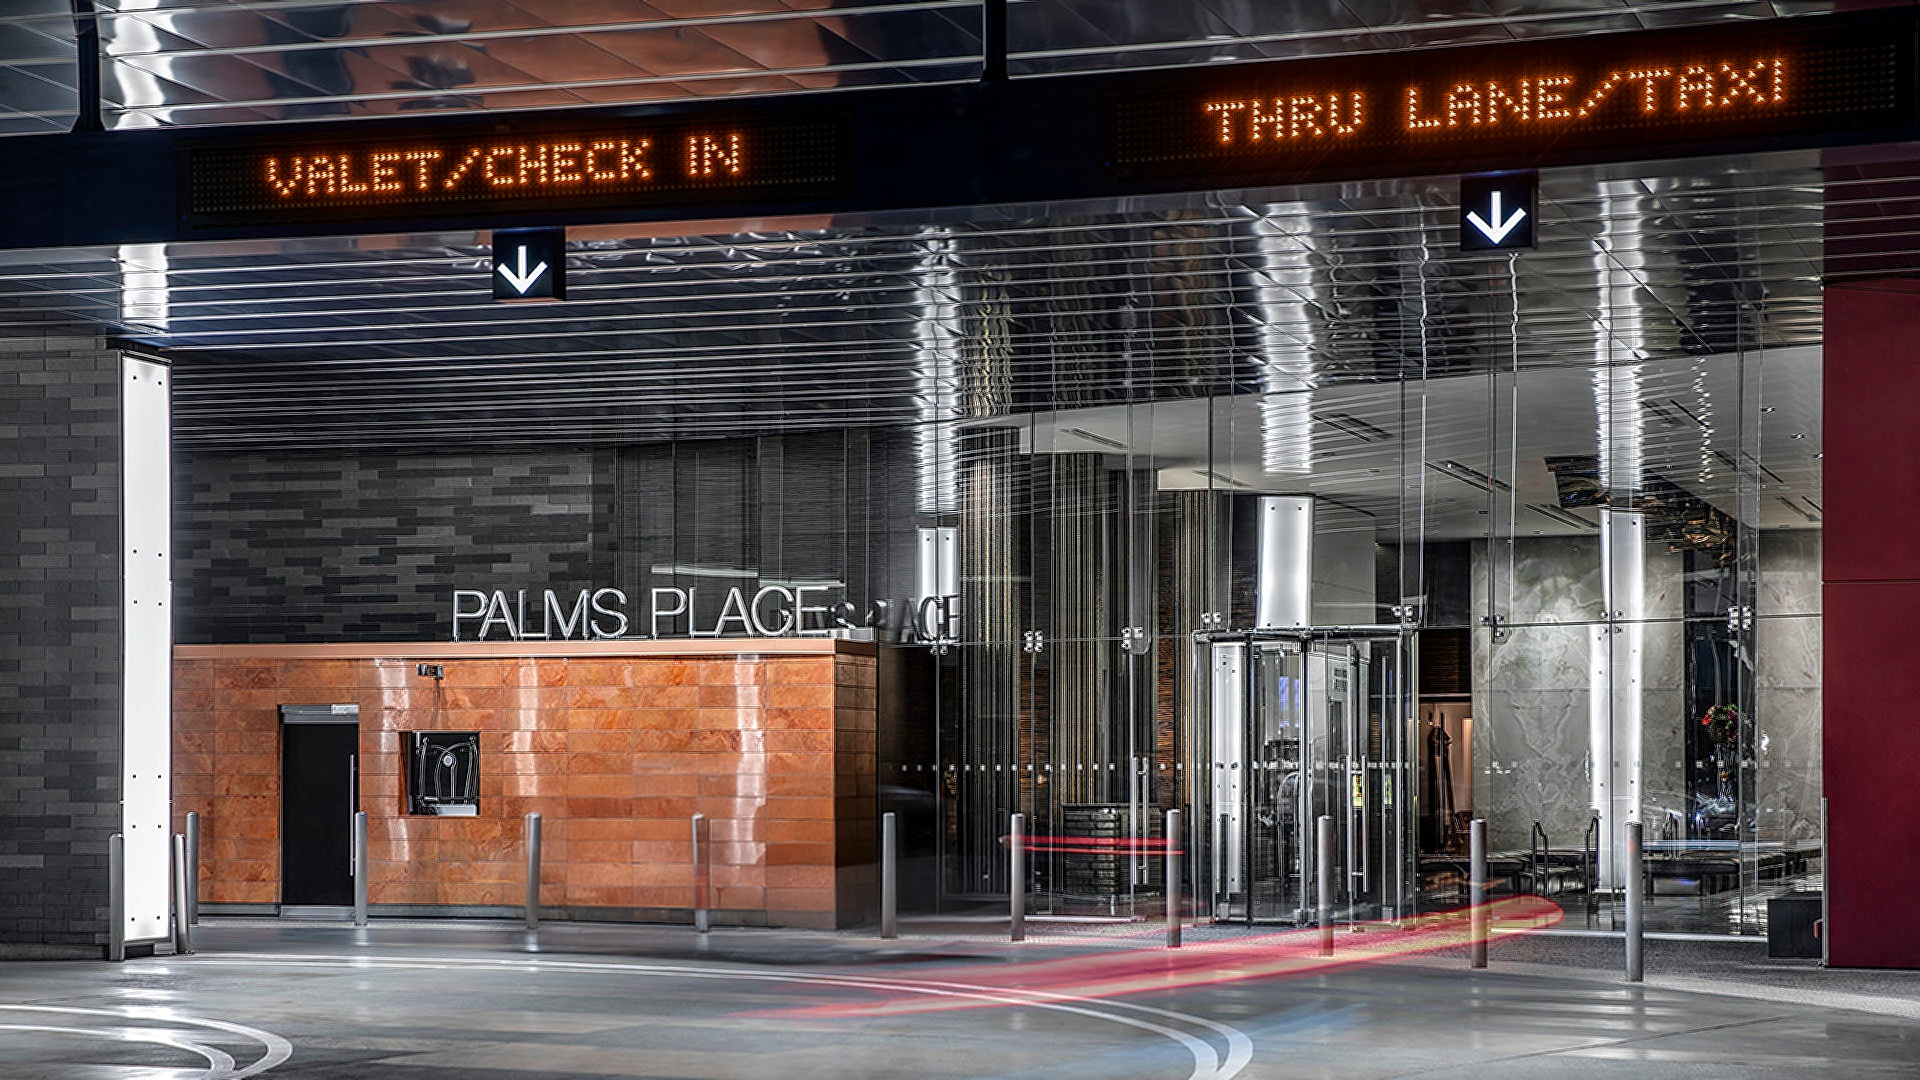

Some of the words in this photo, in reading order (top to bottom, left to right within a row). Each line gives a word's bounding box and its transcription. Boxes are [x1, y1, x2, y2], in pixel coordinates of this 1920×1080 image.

[1203, 91, 1365, 144] THRU
[1405, 58, 1785, 131] LANE/TAXI
[265, 136, 652, 196] VALET/CHECK
[686, 133, 741, 177] IN
[452, 587, 629, 640] PALMS
